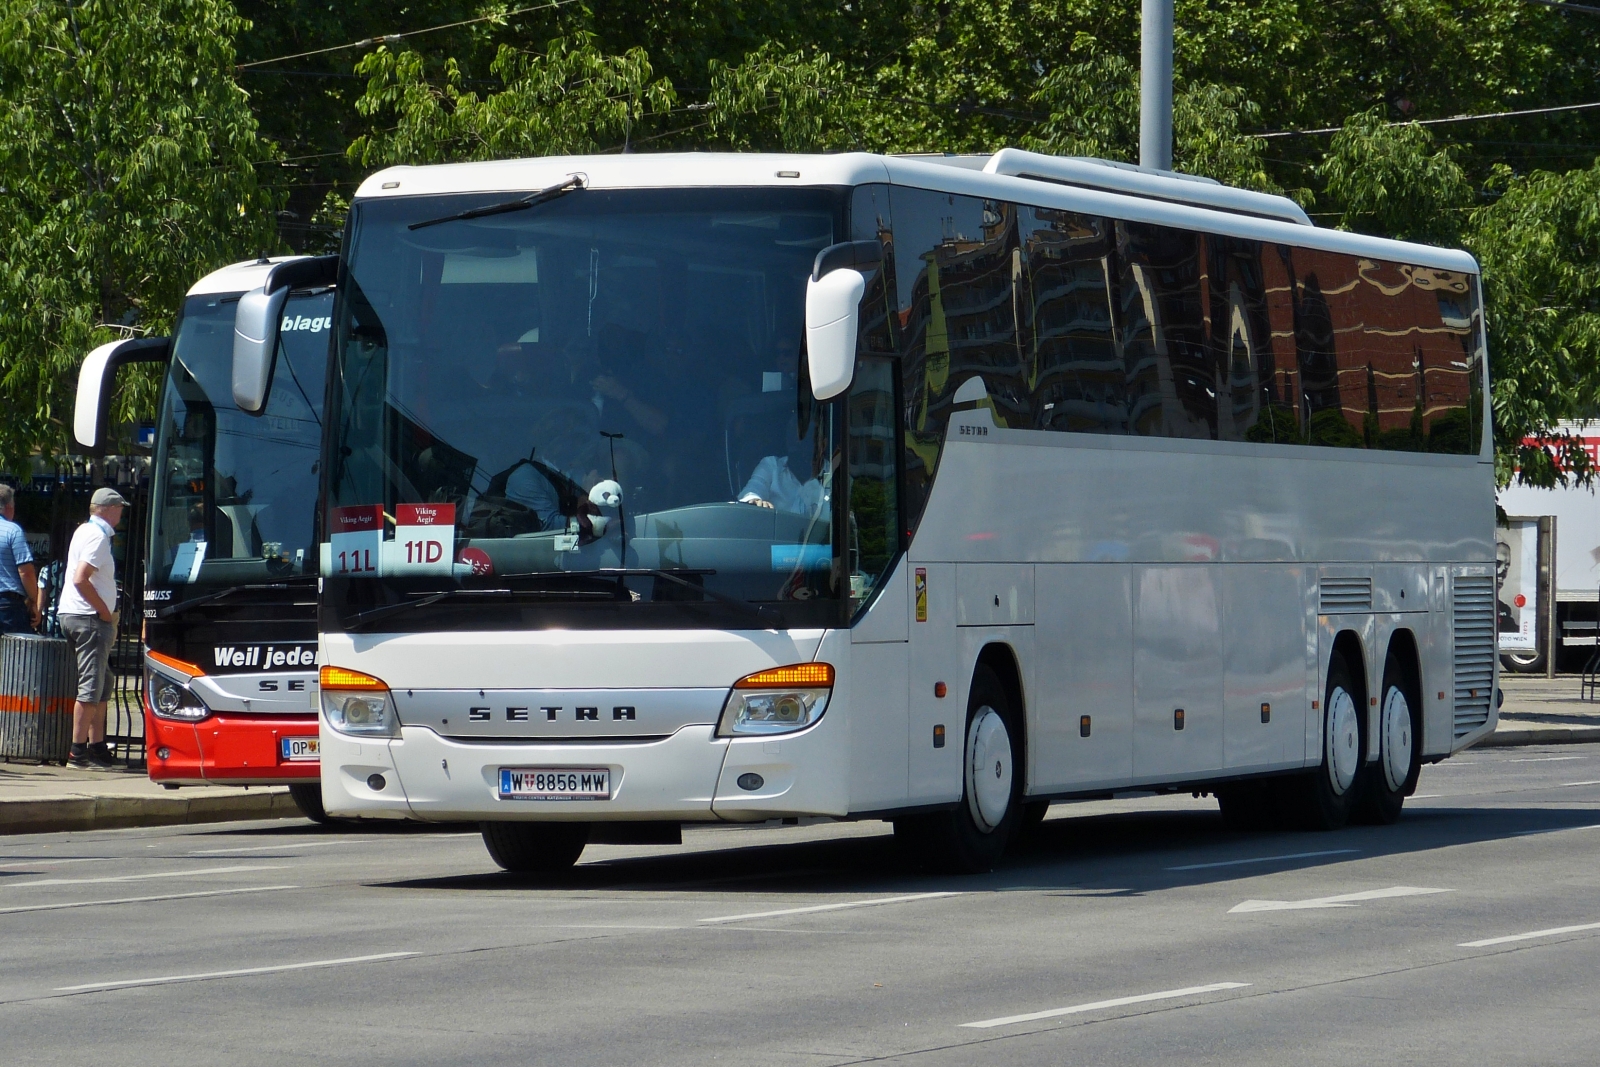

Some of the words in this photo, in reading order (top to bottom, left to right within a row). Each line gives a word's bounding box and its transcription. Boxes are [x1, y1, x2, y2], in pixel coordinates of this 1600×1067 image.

[959, 425, 988, 436] SETRA
[415, 507, 437, 517] Viking
[340, 516, 358, 524] Viking
[358, 515, 372, 524] Aegir
[416, 515, 434, 524] Aegir
[404, 540, 443, 563] 11D
[338, 549, 375, 574] 11L
[214, 646, 260, 667] Weil
[468, 706, 636, 722] SETRA
[292, 741, 308, 754] OP
[511, 773, 523, 791] W
[536, 773, 577, 791] 8856
[581, 774, 605, 791] MW
